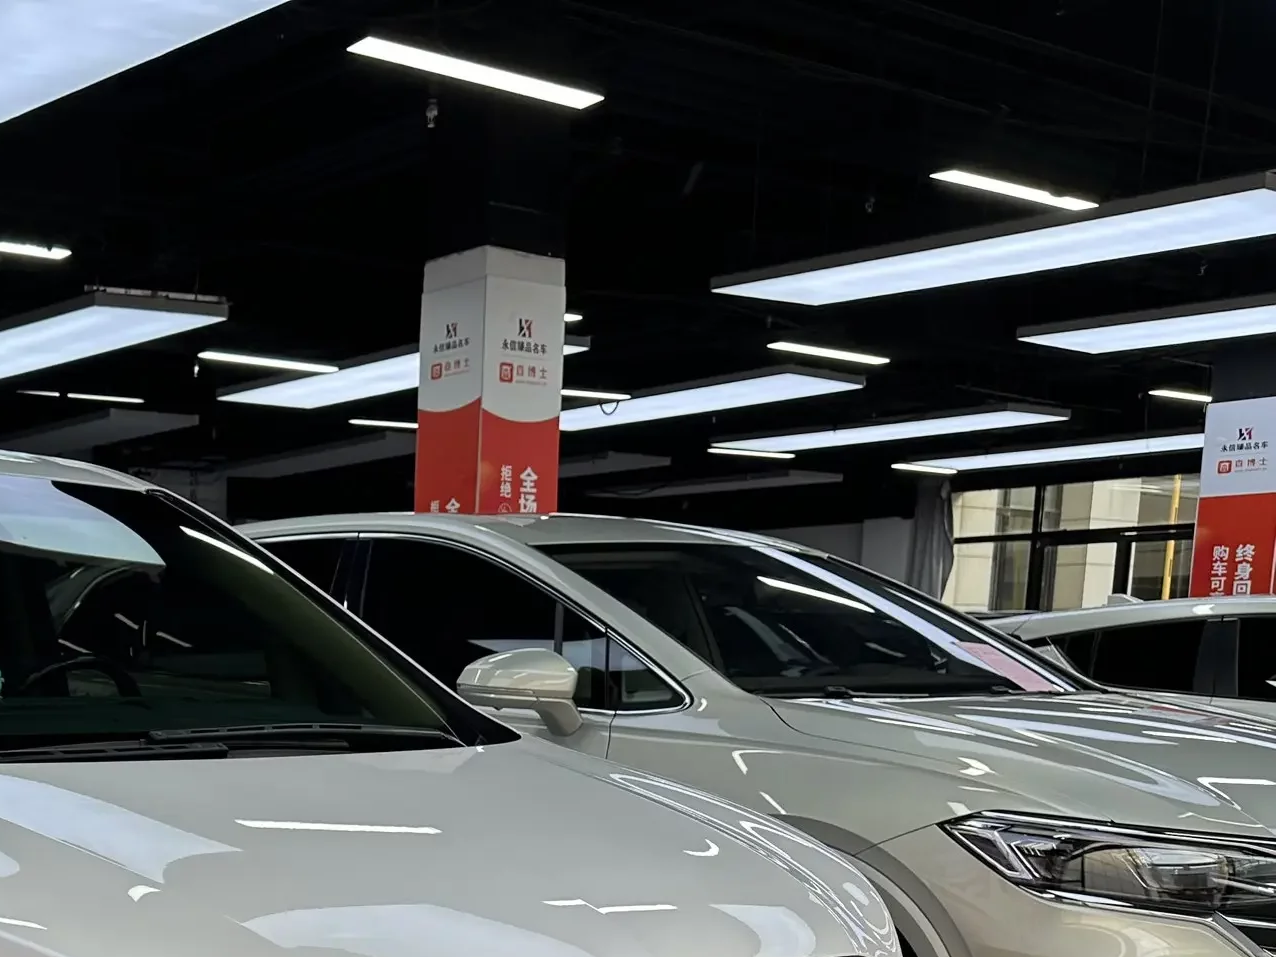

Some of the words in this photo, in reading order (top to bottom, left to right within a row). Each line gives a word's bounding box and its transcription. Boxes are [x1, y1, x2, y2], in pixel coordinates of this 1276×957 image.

[502, 338, 548, 355] 永信臻品名车
[1209, 545, 1230, 595] 购车可
[1232, 544, 1256, 595] 终身回
